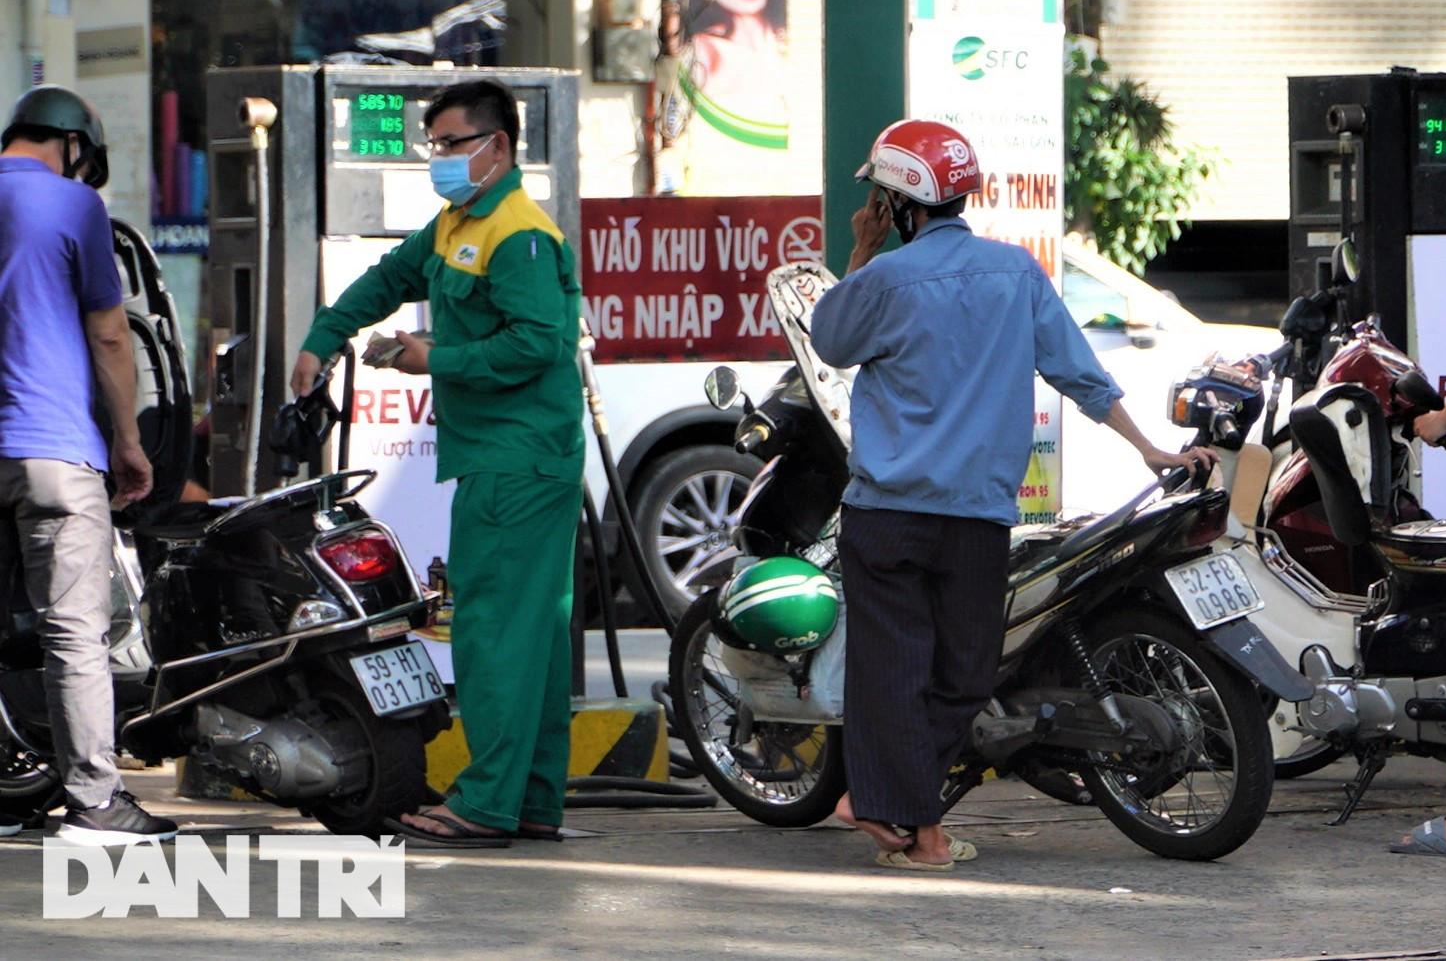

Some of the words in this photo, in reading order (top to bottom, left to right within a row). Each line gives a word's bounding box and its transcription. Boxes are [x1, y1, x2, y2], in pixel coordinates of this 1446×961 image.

[985, 50, 1028, 69] SFC
[380, 116, 404, 133] 185
[359, 139, 404, 155] 31570
[589, 215, 642, 273] VÀO
[652, 228, 706, 273] KHU
[715, 219, 769, 281] VỰC
[634, 284, 724, 348] NHẬP
[1304, 544, 1335, 554] HONDA
[1179, 558, 1235, 595] 52-F8
[1195, 584, 1250, 621] 0986
[775, 630, 820, 648] Grab
[363, 647, 421, 681] 59-H1
[371, 672, 441, 710] 031.78
